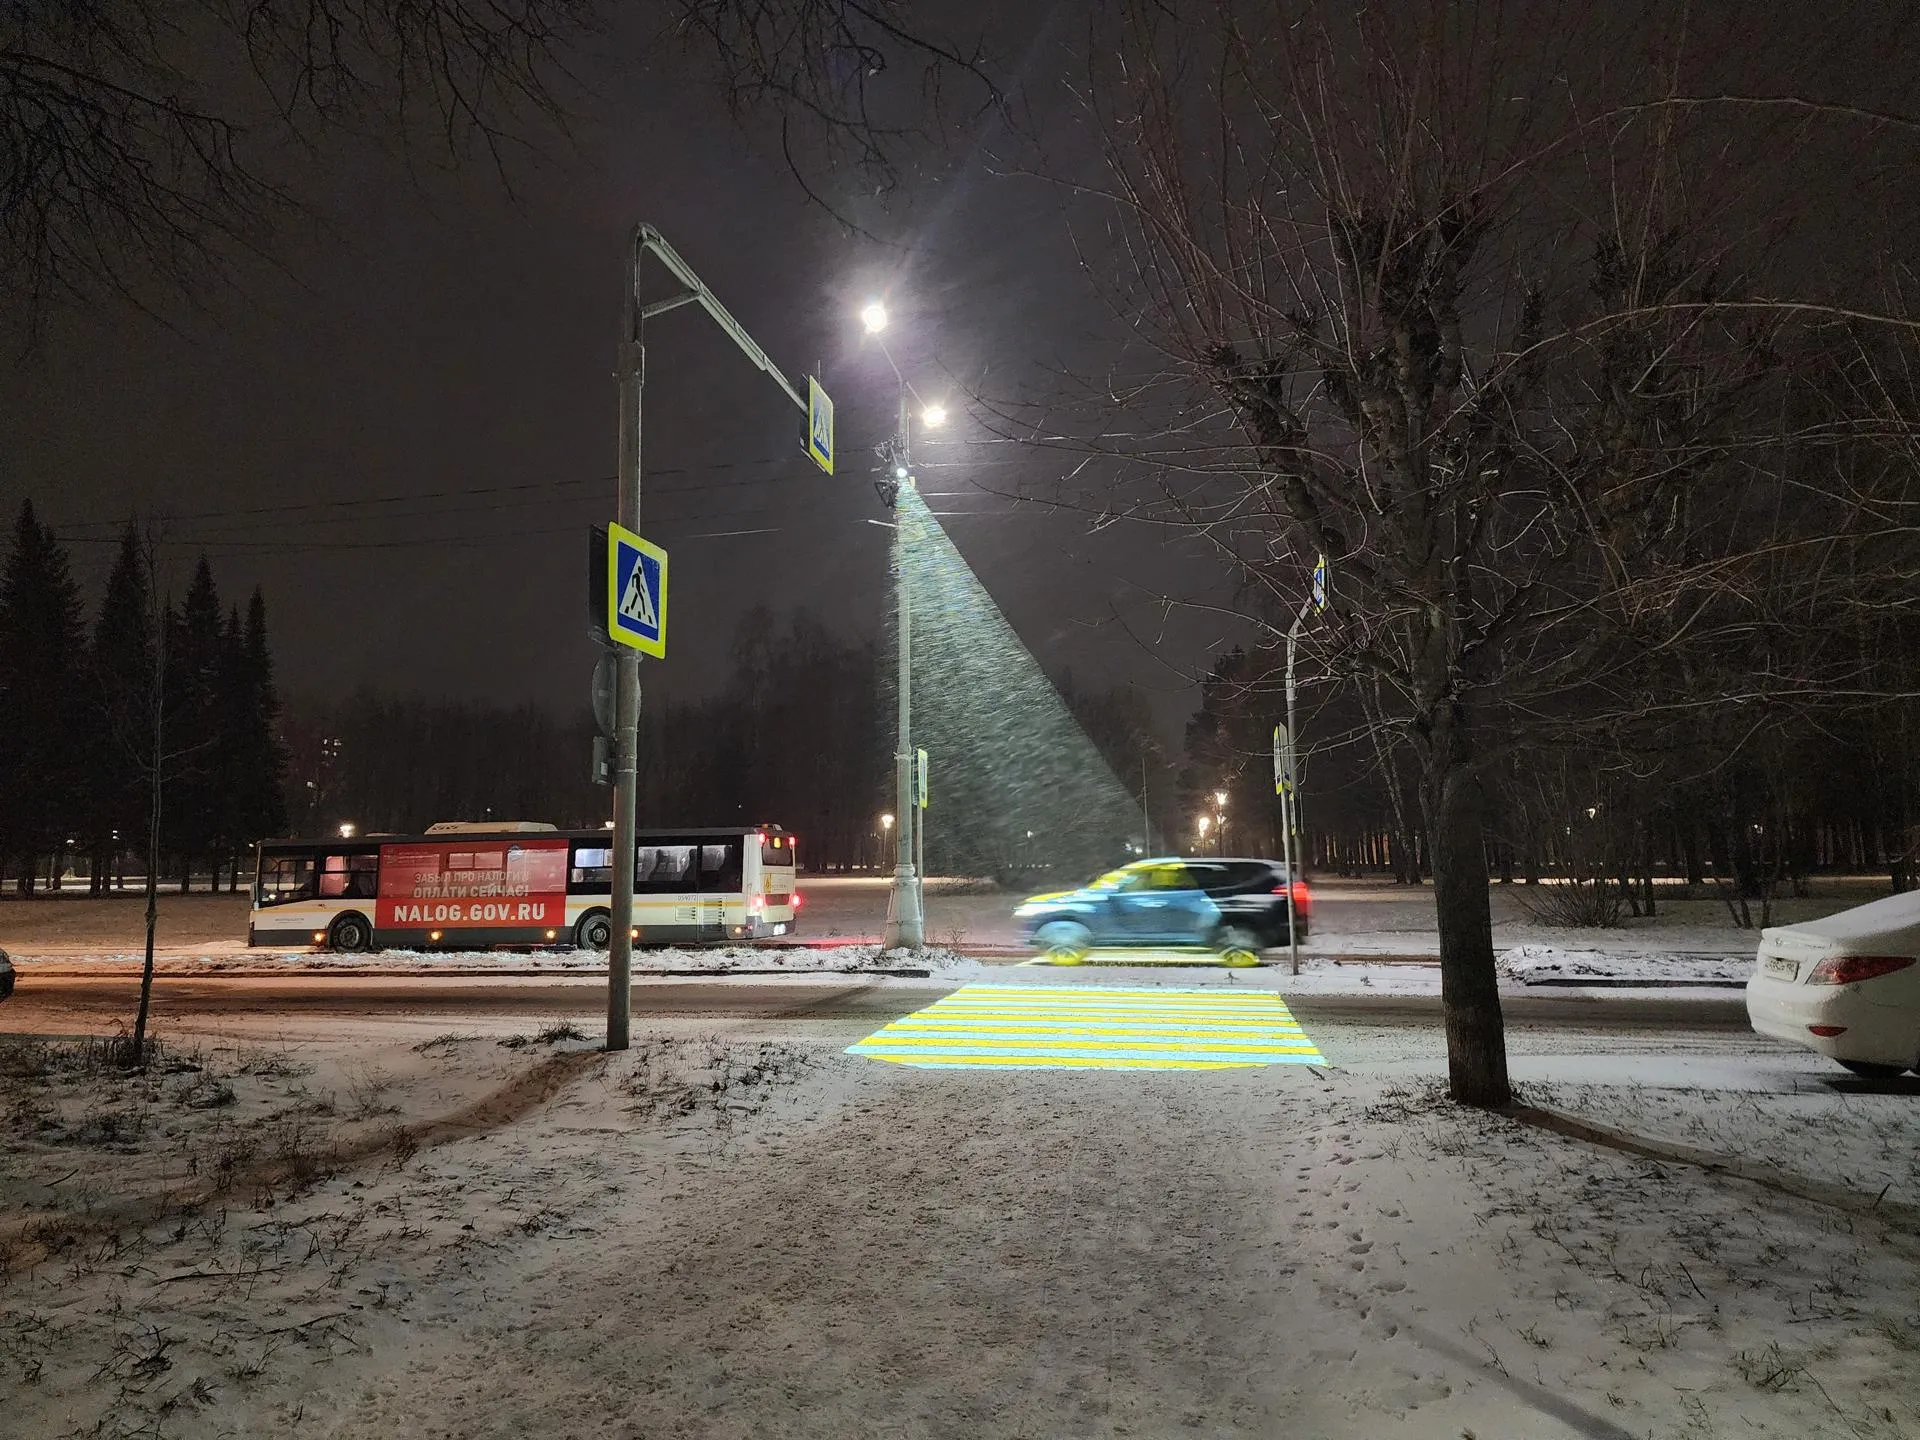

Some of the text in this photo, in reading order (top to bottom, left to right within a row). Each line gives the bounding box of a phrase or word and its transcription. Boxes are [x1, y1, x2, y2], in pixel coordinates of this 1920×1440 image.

[415, 871, 450, 883] ЗАБЫЛ
[454, 871, 474, 882] ПРО
[413, 883, 529, 898] ОПЛАТИ СЕЙЧАС!
[394, 903, 545, 922] NALOG.GOV.RU
